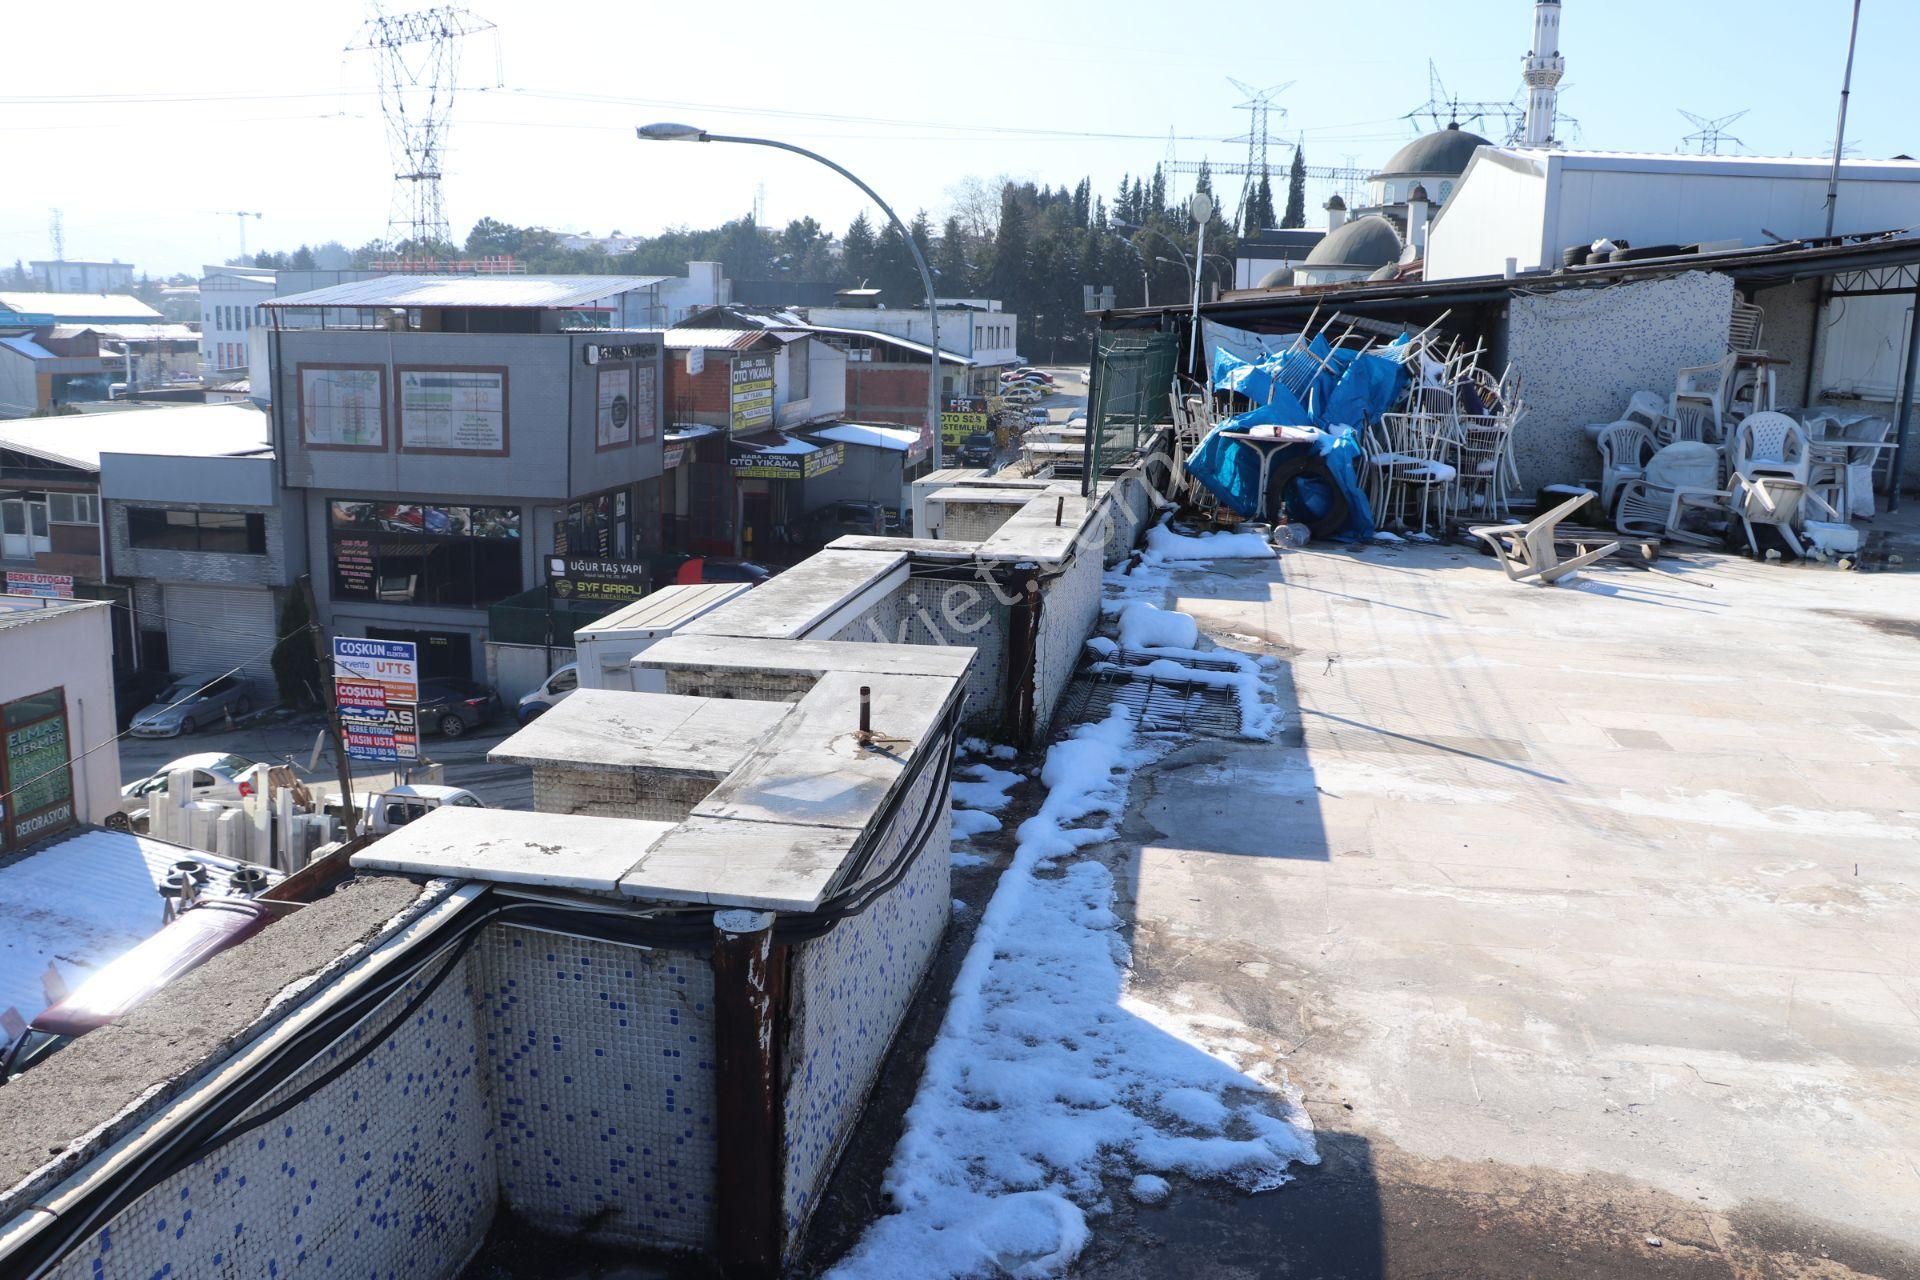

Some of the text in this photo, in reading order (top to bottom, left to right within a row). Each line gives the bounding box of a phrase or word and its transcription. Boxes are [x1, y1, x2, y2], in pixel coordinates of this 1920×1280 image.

[734, 367, 772, 382] OTO YIKAMA
[730, 458, 800, 468] OTO YIKAMA
[570, 560, 642, 574] UĞUR TAŞ YAPI
[8, 572, 71, 585] BERKE OTOGAZ
[577, 582, 642, 595] SYF GARAJ
[340, 641, 385, 656] COŞKUN
[376, 661, 412, 675] UTTS
[339, 685, 385, 699] COŞKUN
[9, 718, 61, 747] ELMAS
[348, 724, 369, 735] BERKE
[369, 726, 394, 736] OTOGAZ
[11, 732, 65, 760] MERMER
[349, 735, 373, 746] YASİN
[374, 736, 396, 748] USTA
[16, 804, 71, 838] DEKORASYON
